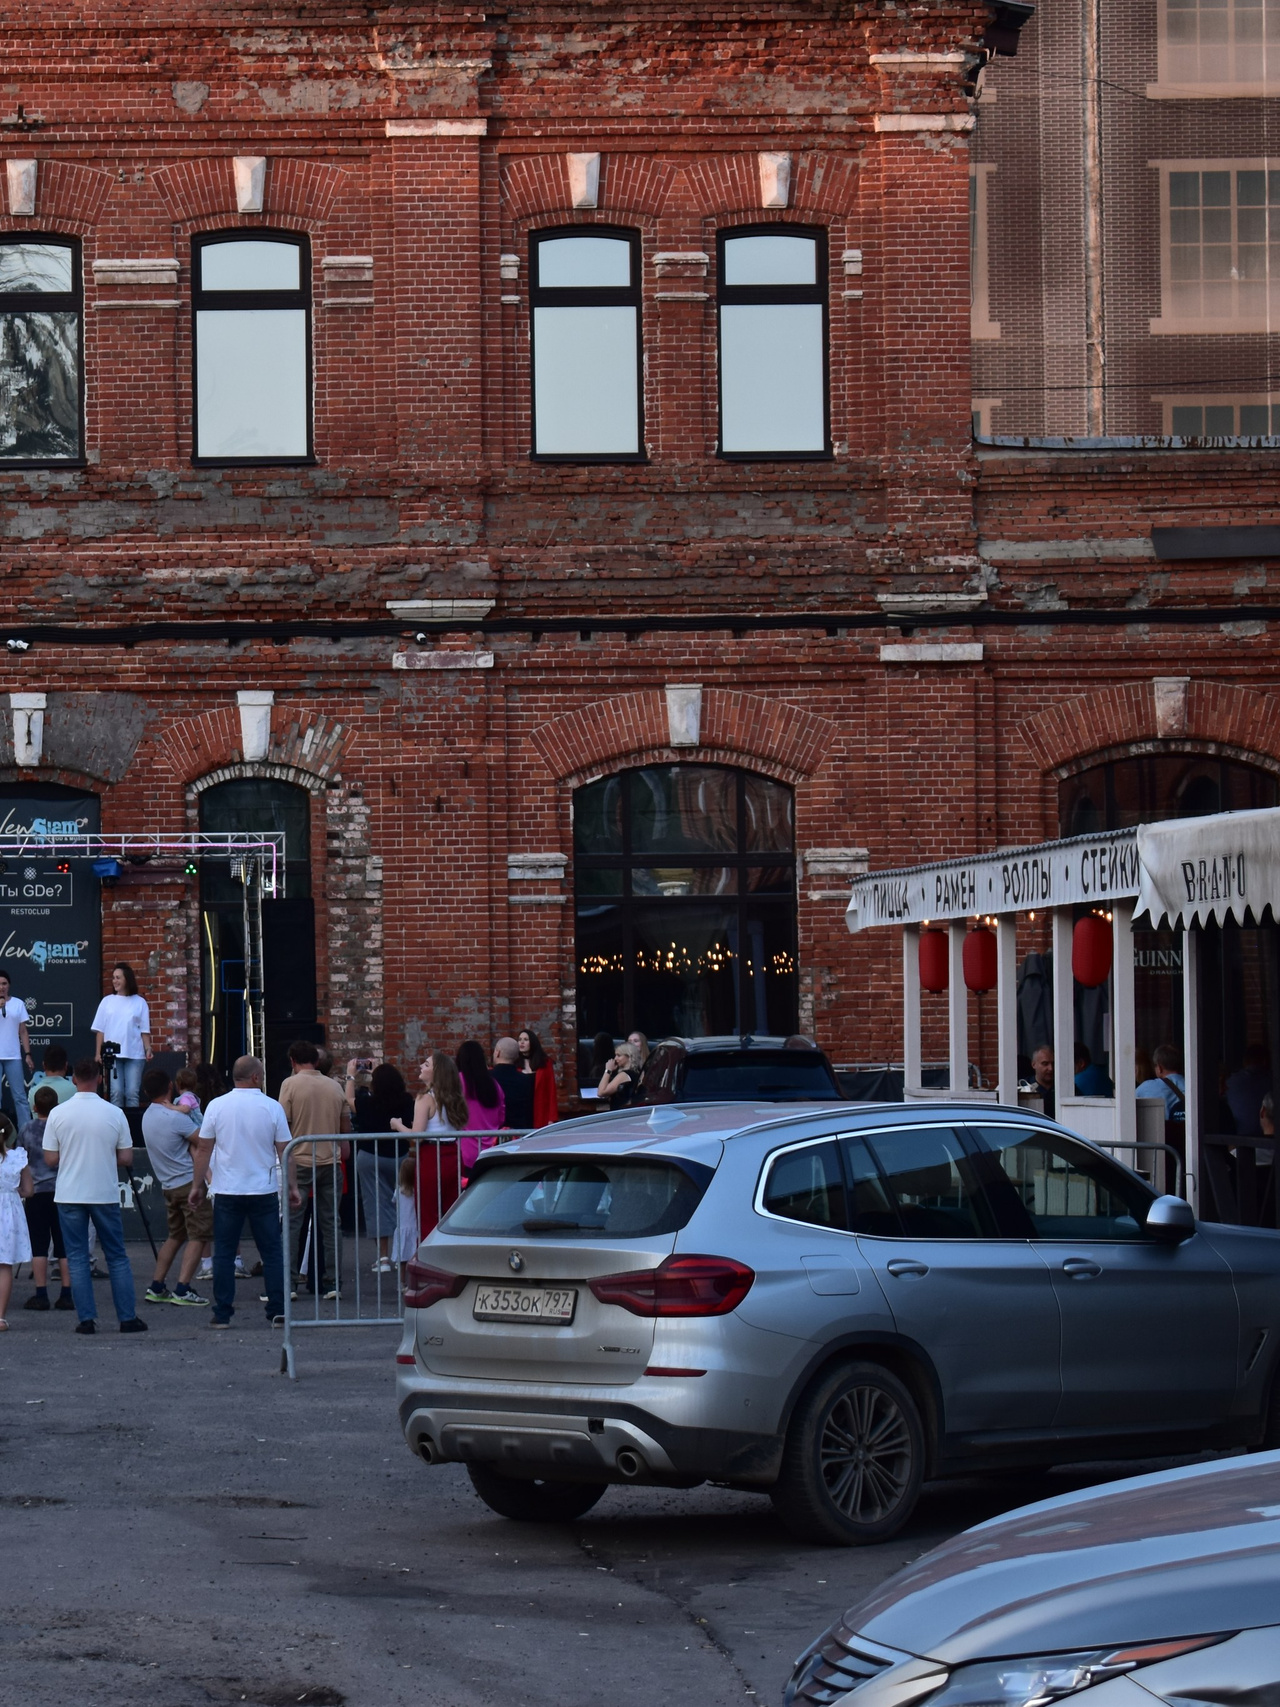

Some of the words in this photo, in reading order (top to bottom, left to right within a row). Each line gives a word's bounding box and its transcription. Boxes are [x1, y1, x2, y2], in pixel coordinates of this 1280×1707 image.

[23, 884, 63, 897] GDe?
[873, 881, 910, 919] ПИЦЦА
[935, 870, 976, 912] РАМЕН
[1002, 857, 1051, 904] РОЛЛЫ
[1081, 840, 1140, 894] СТЕЙКИ
